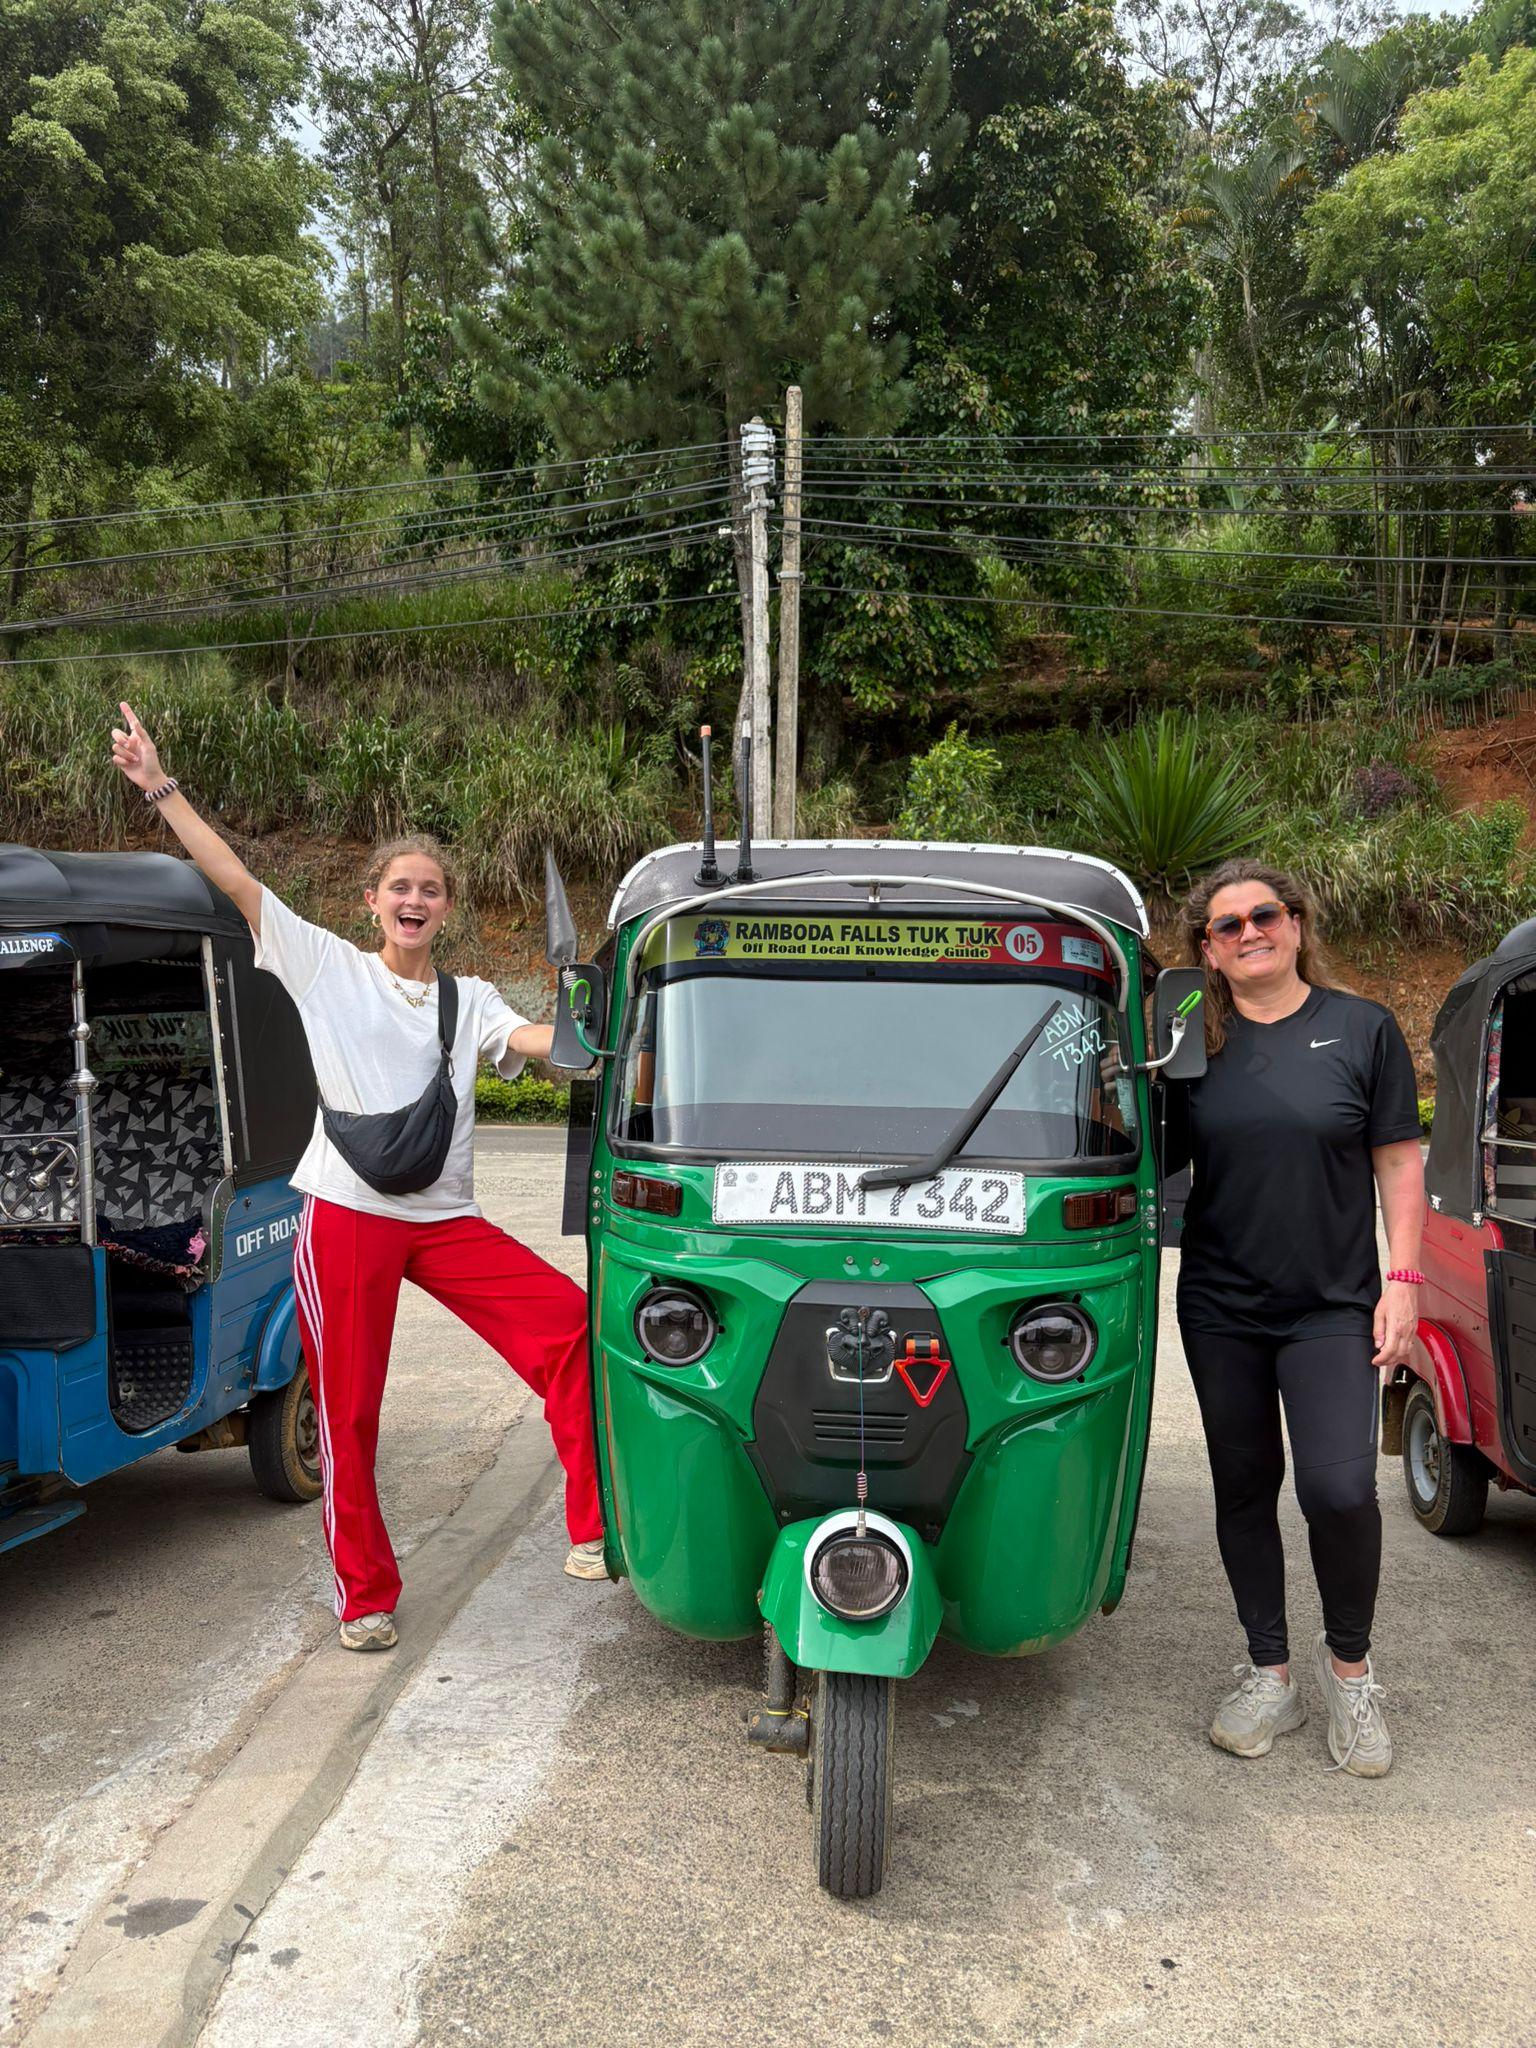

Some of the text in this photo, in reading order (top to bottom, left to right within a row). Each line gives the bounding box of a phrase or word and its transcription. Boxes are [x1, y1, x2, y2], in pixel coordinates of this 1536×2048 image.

[736, 922, 999, 945] RAMBODA FALLS TUK TUK
[742, 942, 989, 958] Off Road Local Knowledge Guide
[1013, 933, 1038, 954] 05
[1044, 1003, 1086, 1043] ABM
[1052, 1029, 1106, 1071] 7342
[769, 1171, 867, 1216] ABM
[236, 1212, 304, 1257] OFF ROA
